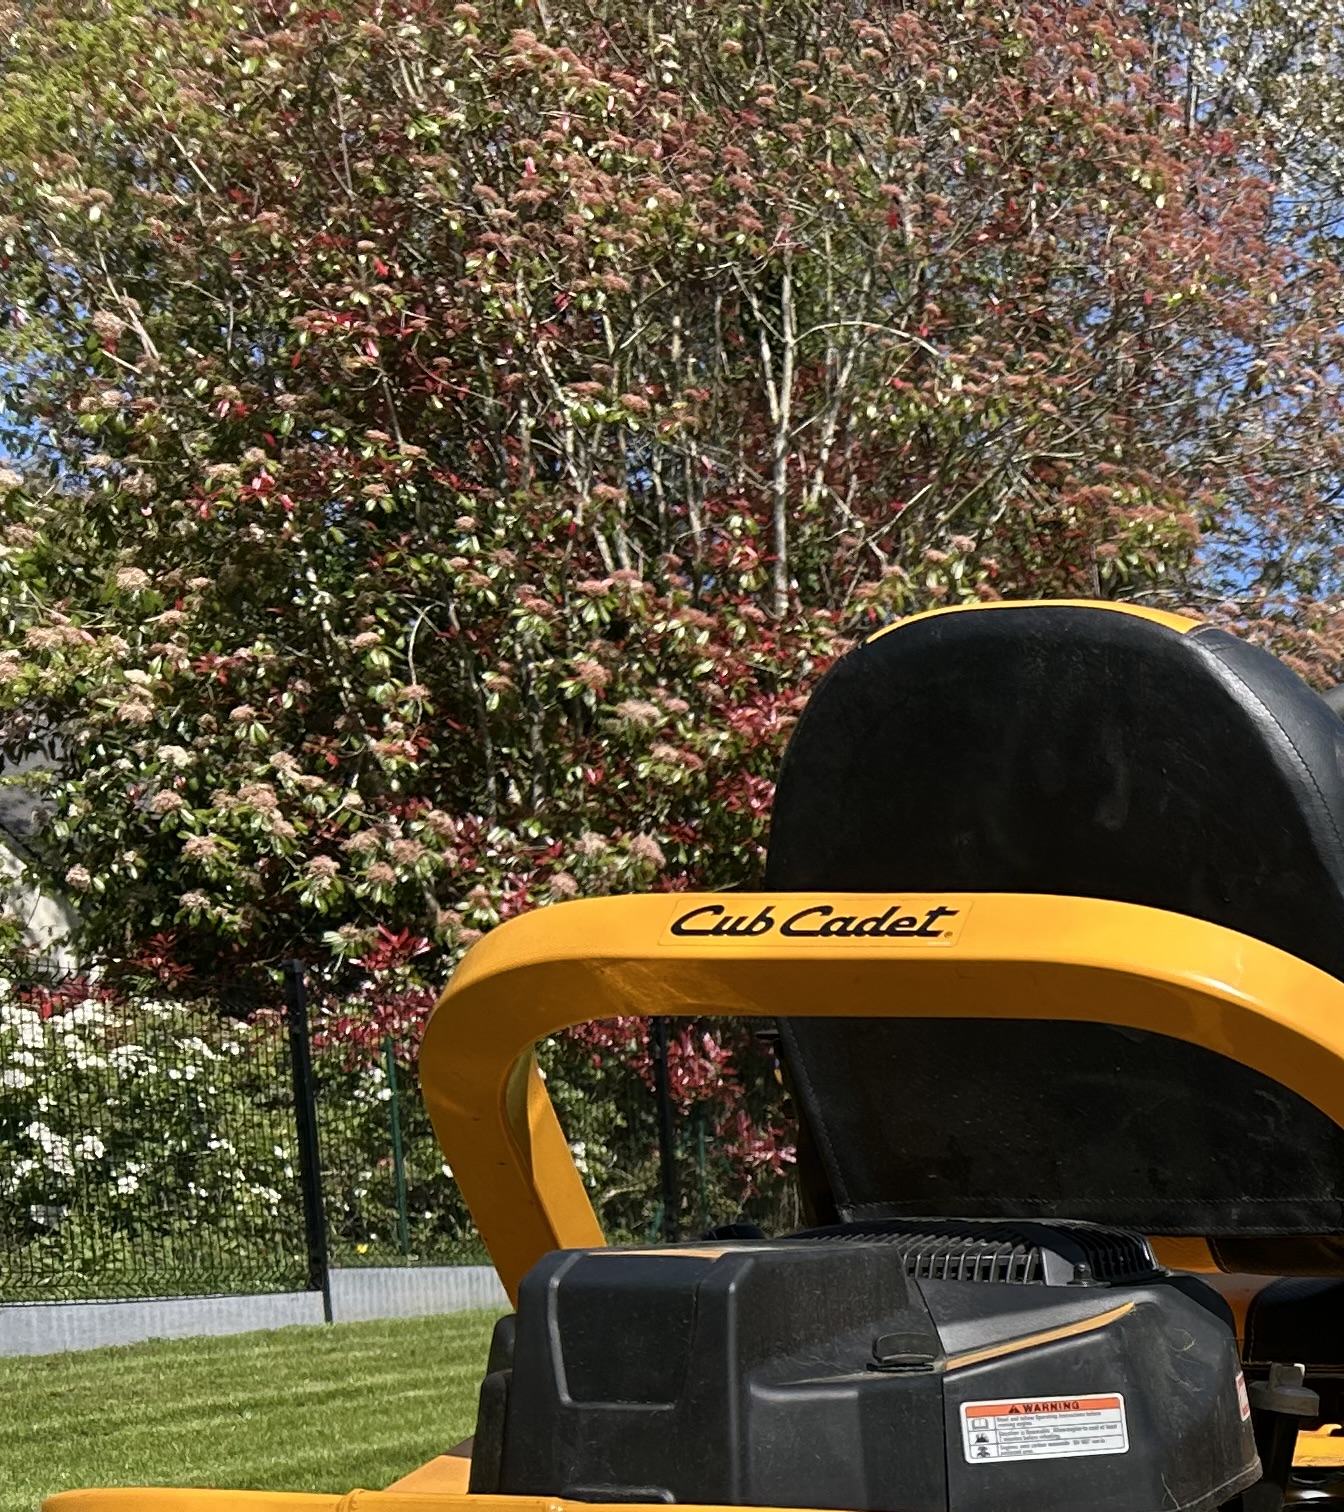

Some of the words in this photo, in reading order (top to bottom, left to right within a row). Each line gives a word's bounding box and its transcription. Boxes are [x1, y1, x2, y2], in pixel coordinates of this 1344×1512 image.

[670, 904, 777, 938] Cub
[779, 904, 960, 938] Cadet
[1022, 1400, 1080, 1414] WARNING
